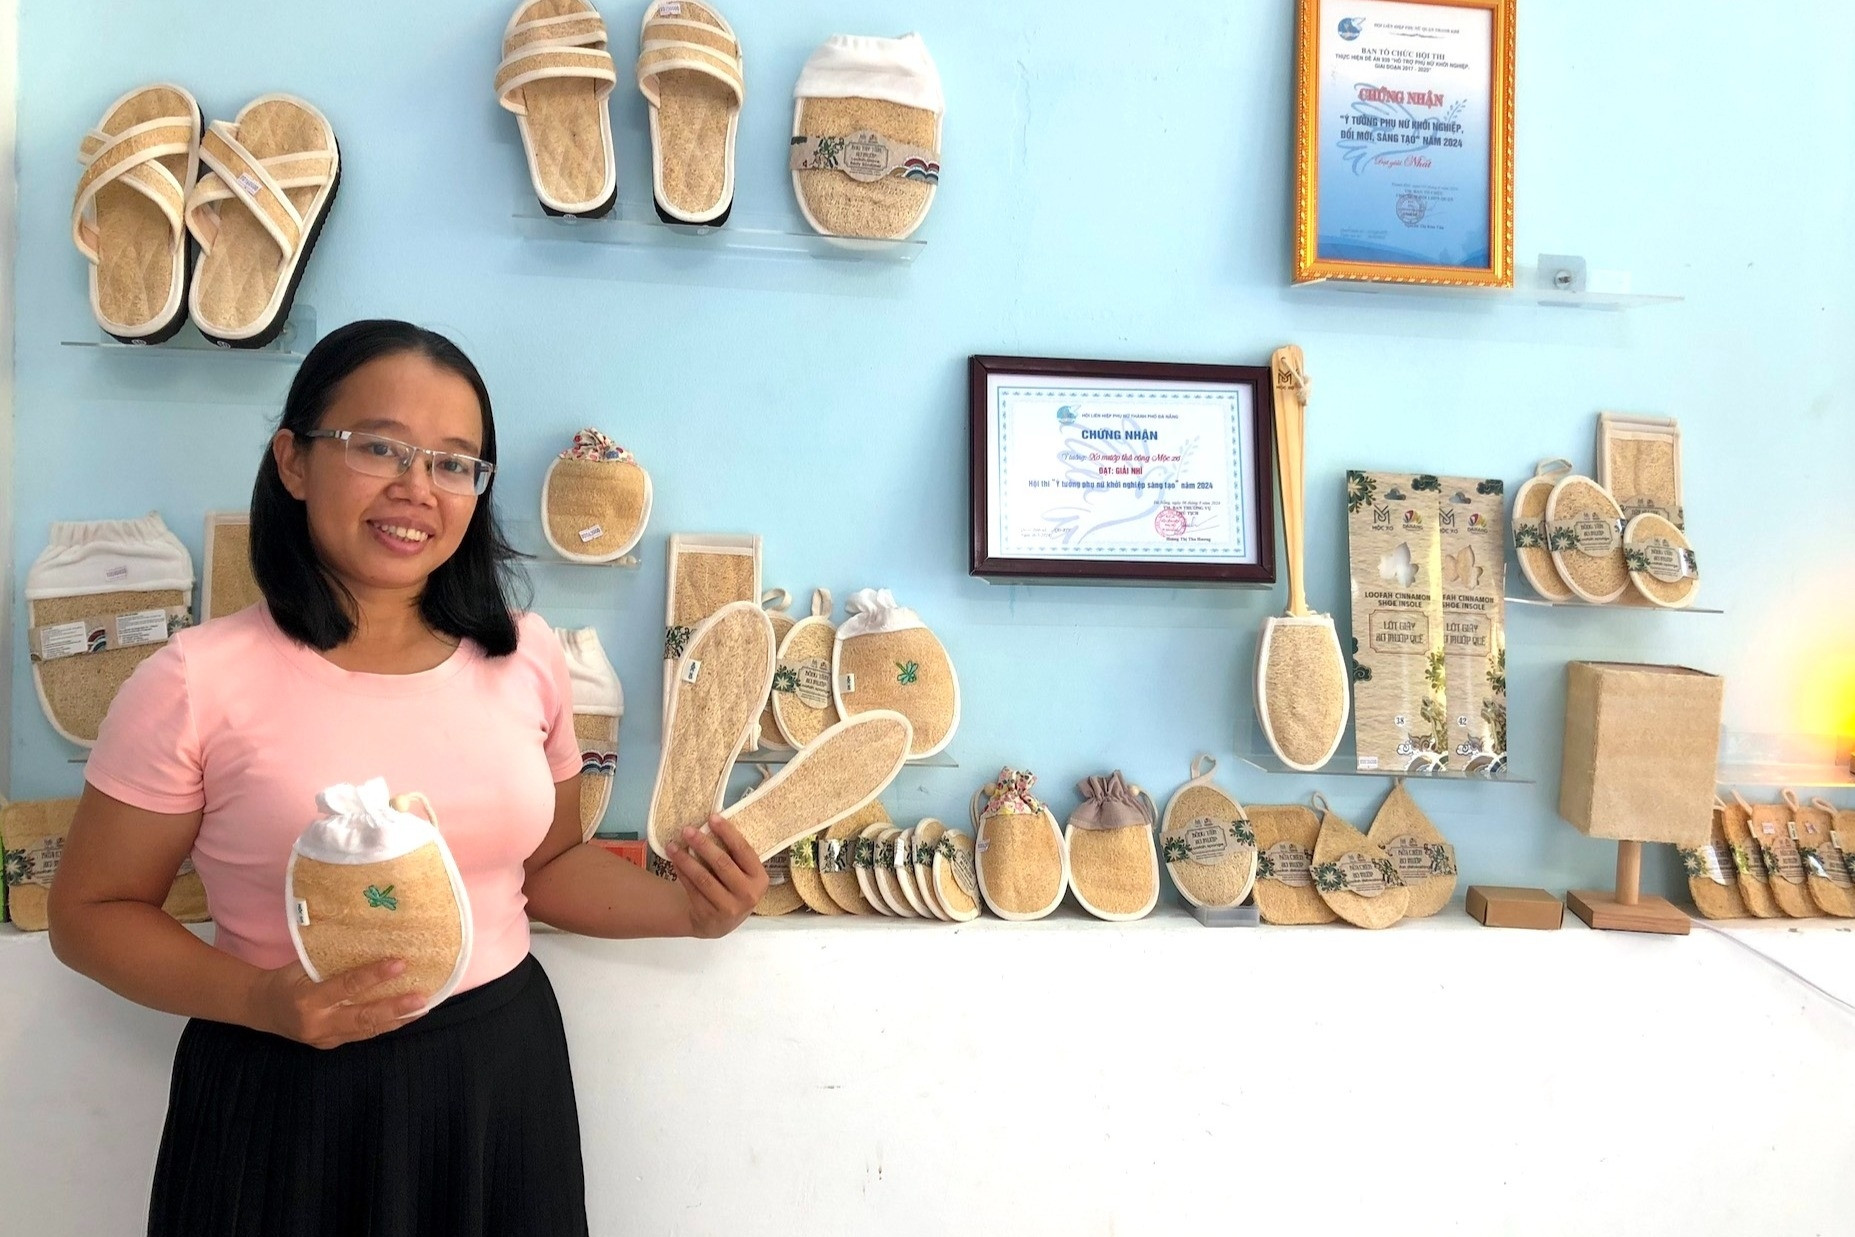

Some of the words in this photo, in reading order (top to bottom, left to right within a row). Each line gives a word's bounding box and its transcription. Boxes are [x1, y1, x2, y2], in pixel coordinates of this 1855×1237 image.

[1358, 86, 1404, 104] CHỨNG
[1407, 90, 1444, 109] NHẬN
[1352, 114, 1378, 126] TƯỞNG
[1380, 118, 1396, 130] PHỤ
[1399, 118, 1410, 129] NỮ
[1412, 119, 1430, 130] KHỞI
[1423, 136, 1441, 146] NĂM
[1444, 138, 1462, 148] 2024
[1082, 428, 1121, 440] CHỨNG
[1125, 428, 1158, 442] NHẬN
[1116, 465, 1129, 475] GIẢI
[1028, 480, 1040, 488] Hội
[1062, 480, 1081, 489] tưởng
[1082, 480, 1094, 490] phụ
[1096, 480, 1104, 488] nữ
[1106, 480, 1121, 488] khởi
[1122, 480, 1146, 490] nghiệp
[1148, 481, 1164, 490] sáng
[1181, 481, 1196, 489] năm
[1196, 482, 1214, 490] 2024
[1458, 595, 1494, 604] CINNAMON
[1462, 602, 1486, 610] INSOLE
[1396, 717, 1405, 725] 38
[1460, 717, 1468, 726] 42
